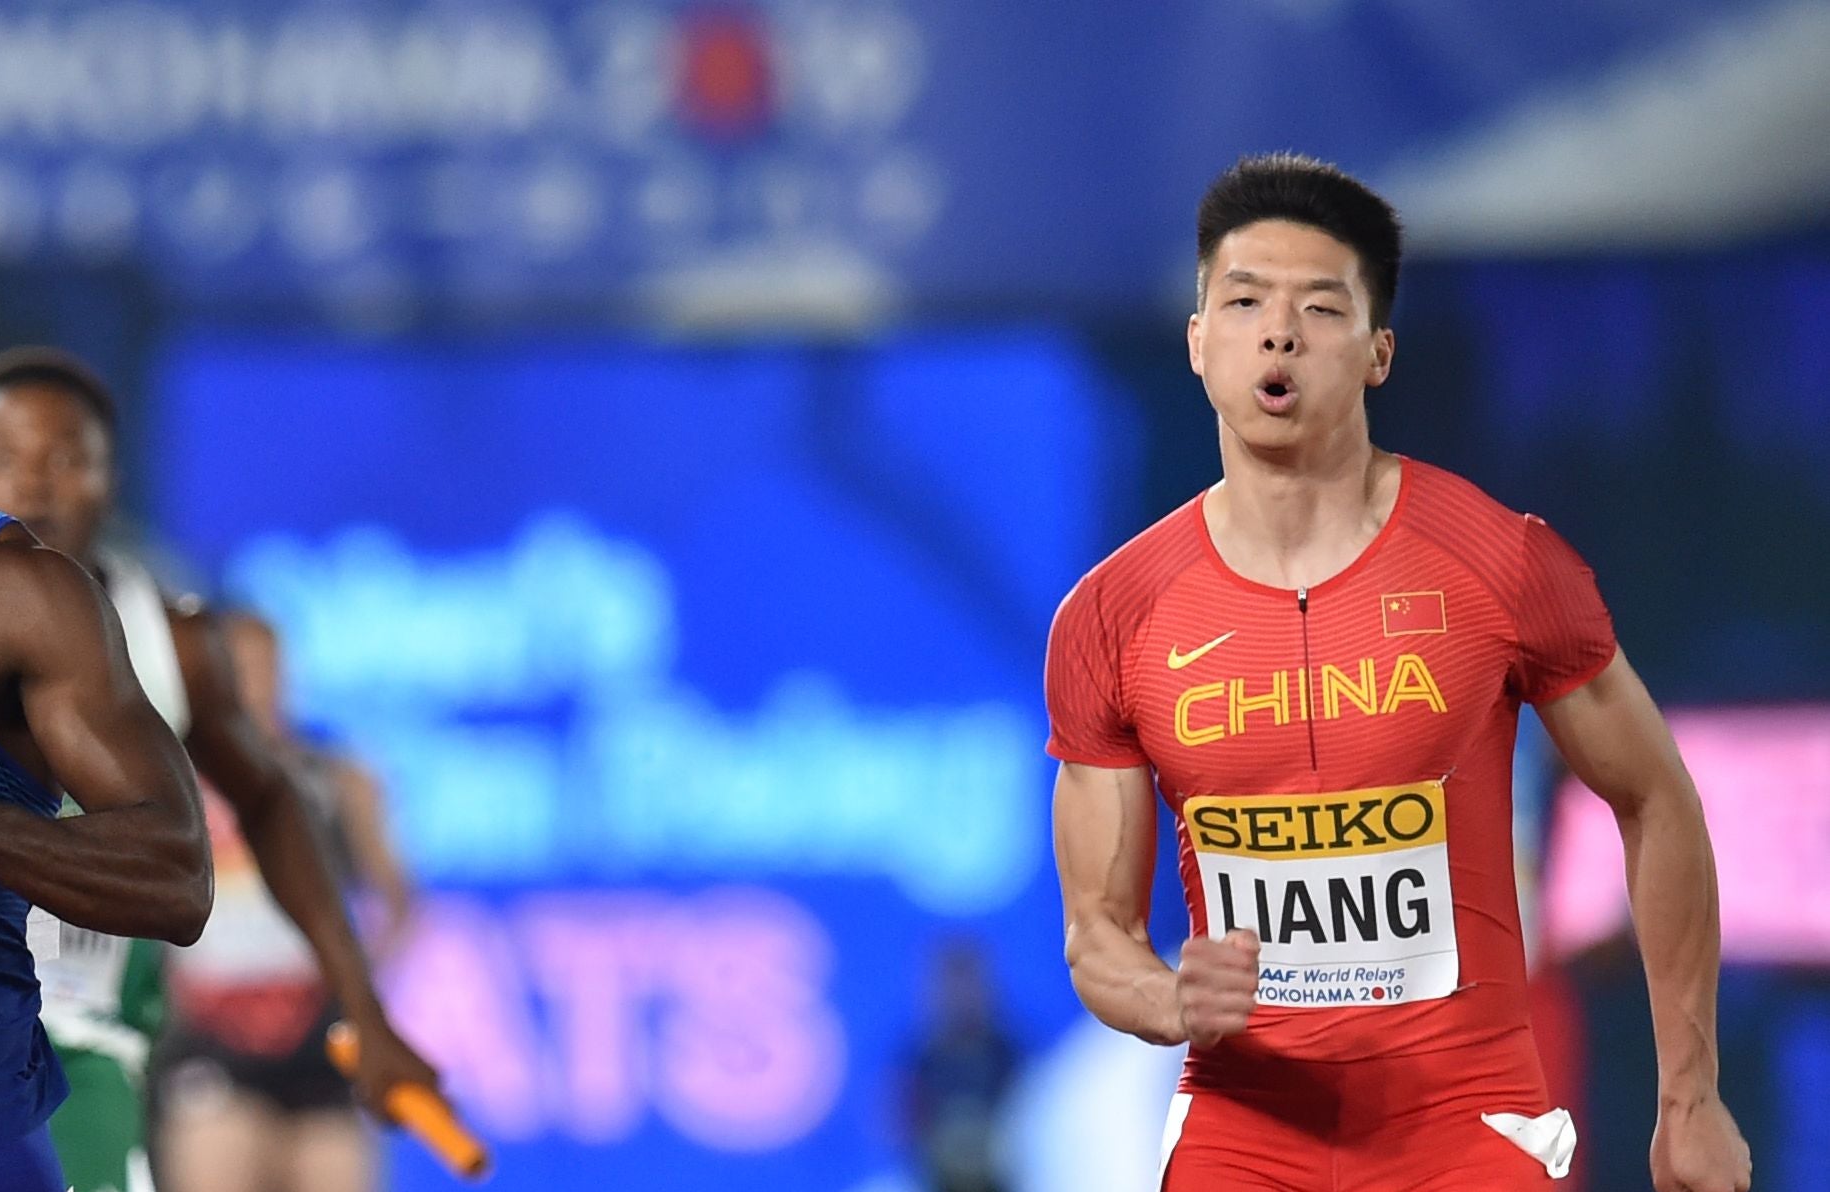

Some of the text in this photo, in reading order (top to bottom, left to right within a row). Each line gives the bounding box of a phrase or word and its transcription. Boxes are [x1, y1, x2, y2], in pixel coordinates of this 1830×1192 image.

[1175, 654, 1448, 746] CHINA
[1194, 794, 1433, 852] SEIKO
[1258, 986, 1354, 1002] YOKOHAMA
[1304, 968, 1351, 983] World
[1354, 967, 1406, 984] Relays
